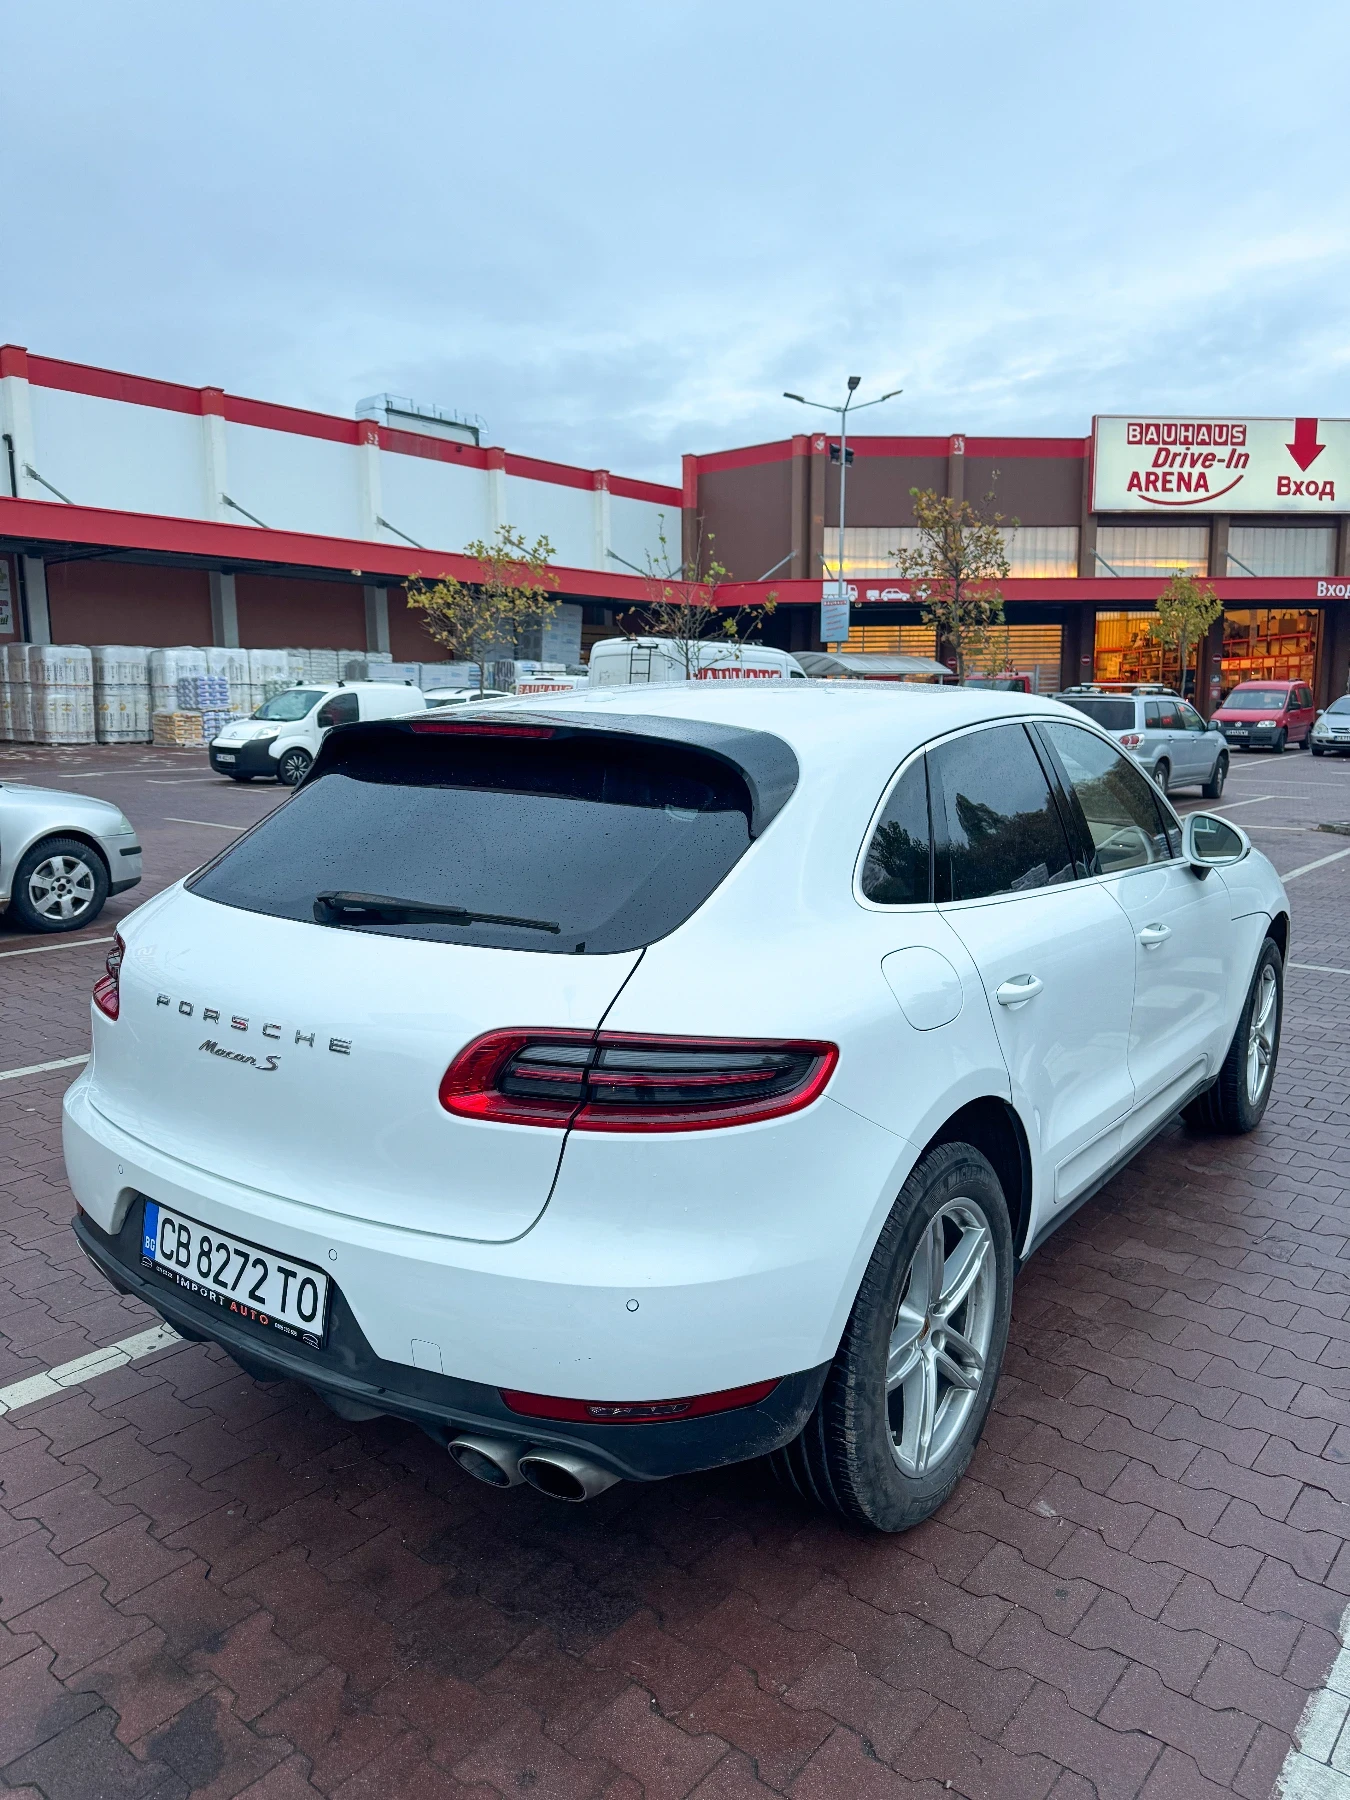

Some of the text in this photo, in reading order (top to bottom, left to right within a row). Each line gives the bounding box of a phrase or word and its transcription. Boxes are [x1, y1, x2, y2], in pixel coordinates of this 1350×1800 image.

[1127, 423, 1247, 446] BAUHAUS
[1151, 446, 1250, 469] Drive-In
[1126, 471, 1210, 493] ARENA
[1276, 476, 1335, 501] Вход
[156, 992, 353, 1056] PORSCHE
[198, 1039, 282, 1072] Macan S
[145, 1235, 156, 1252] BG
[160, 1217, 192, 1269] CB
[196, 1235, 269, 1306] 8272
[176, 1274, 269, 1325] IMPORT AUTO
